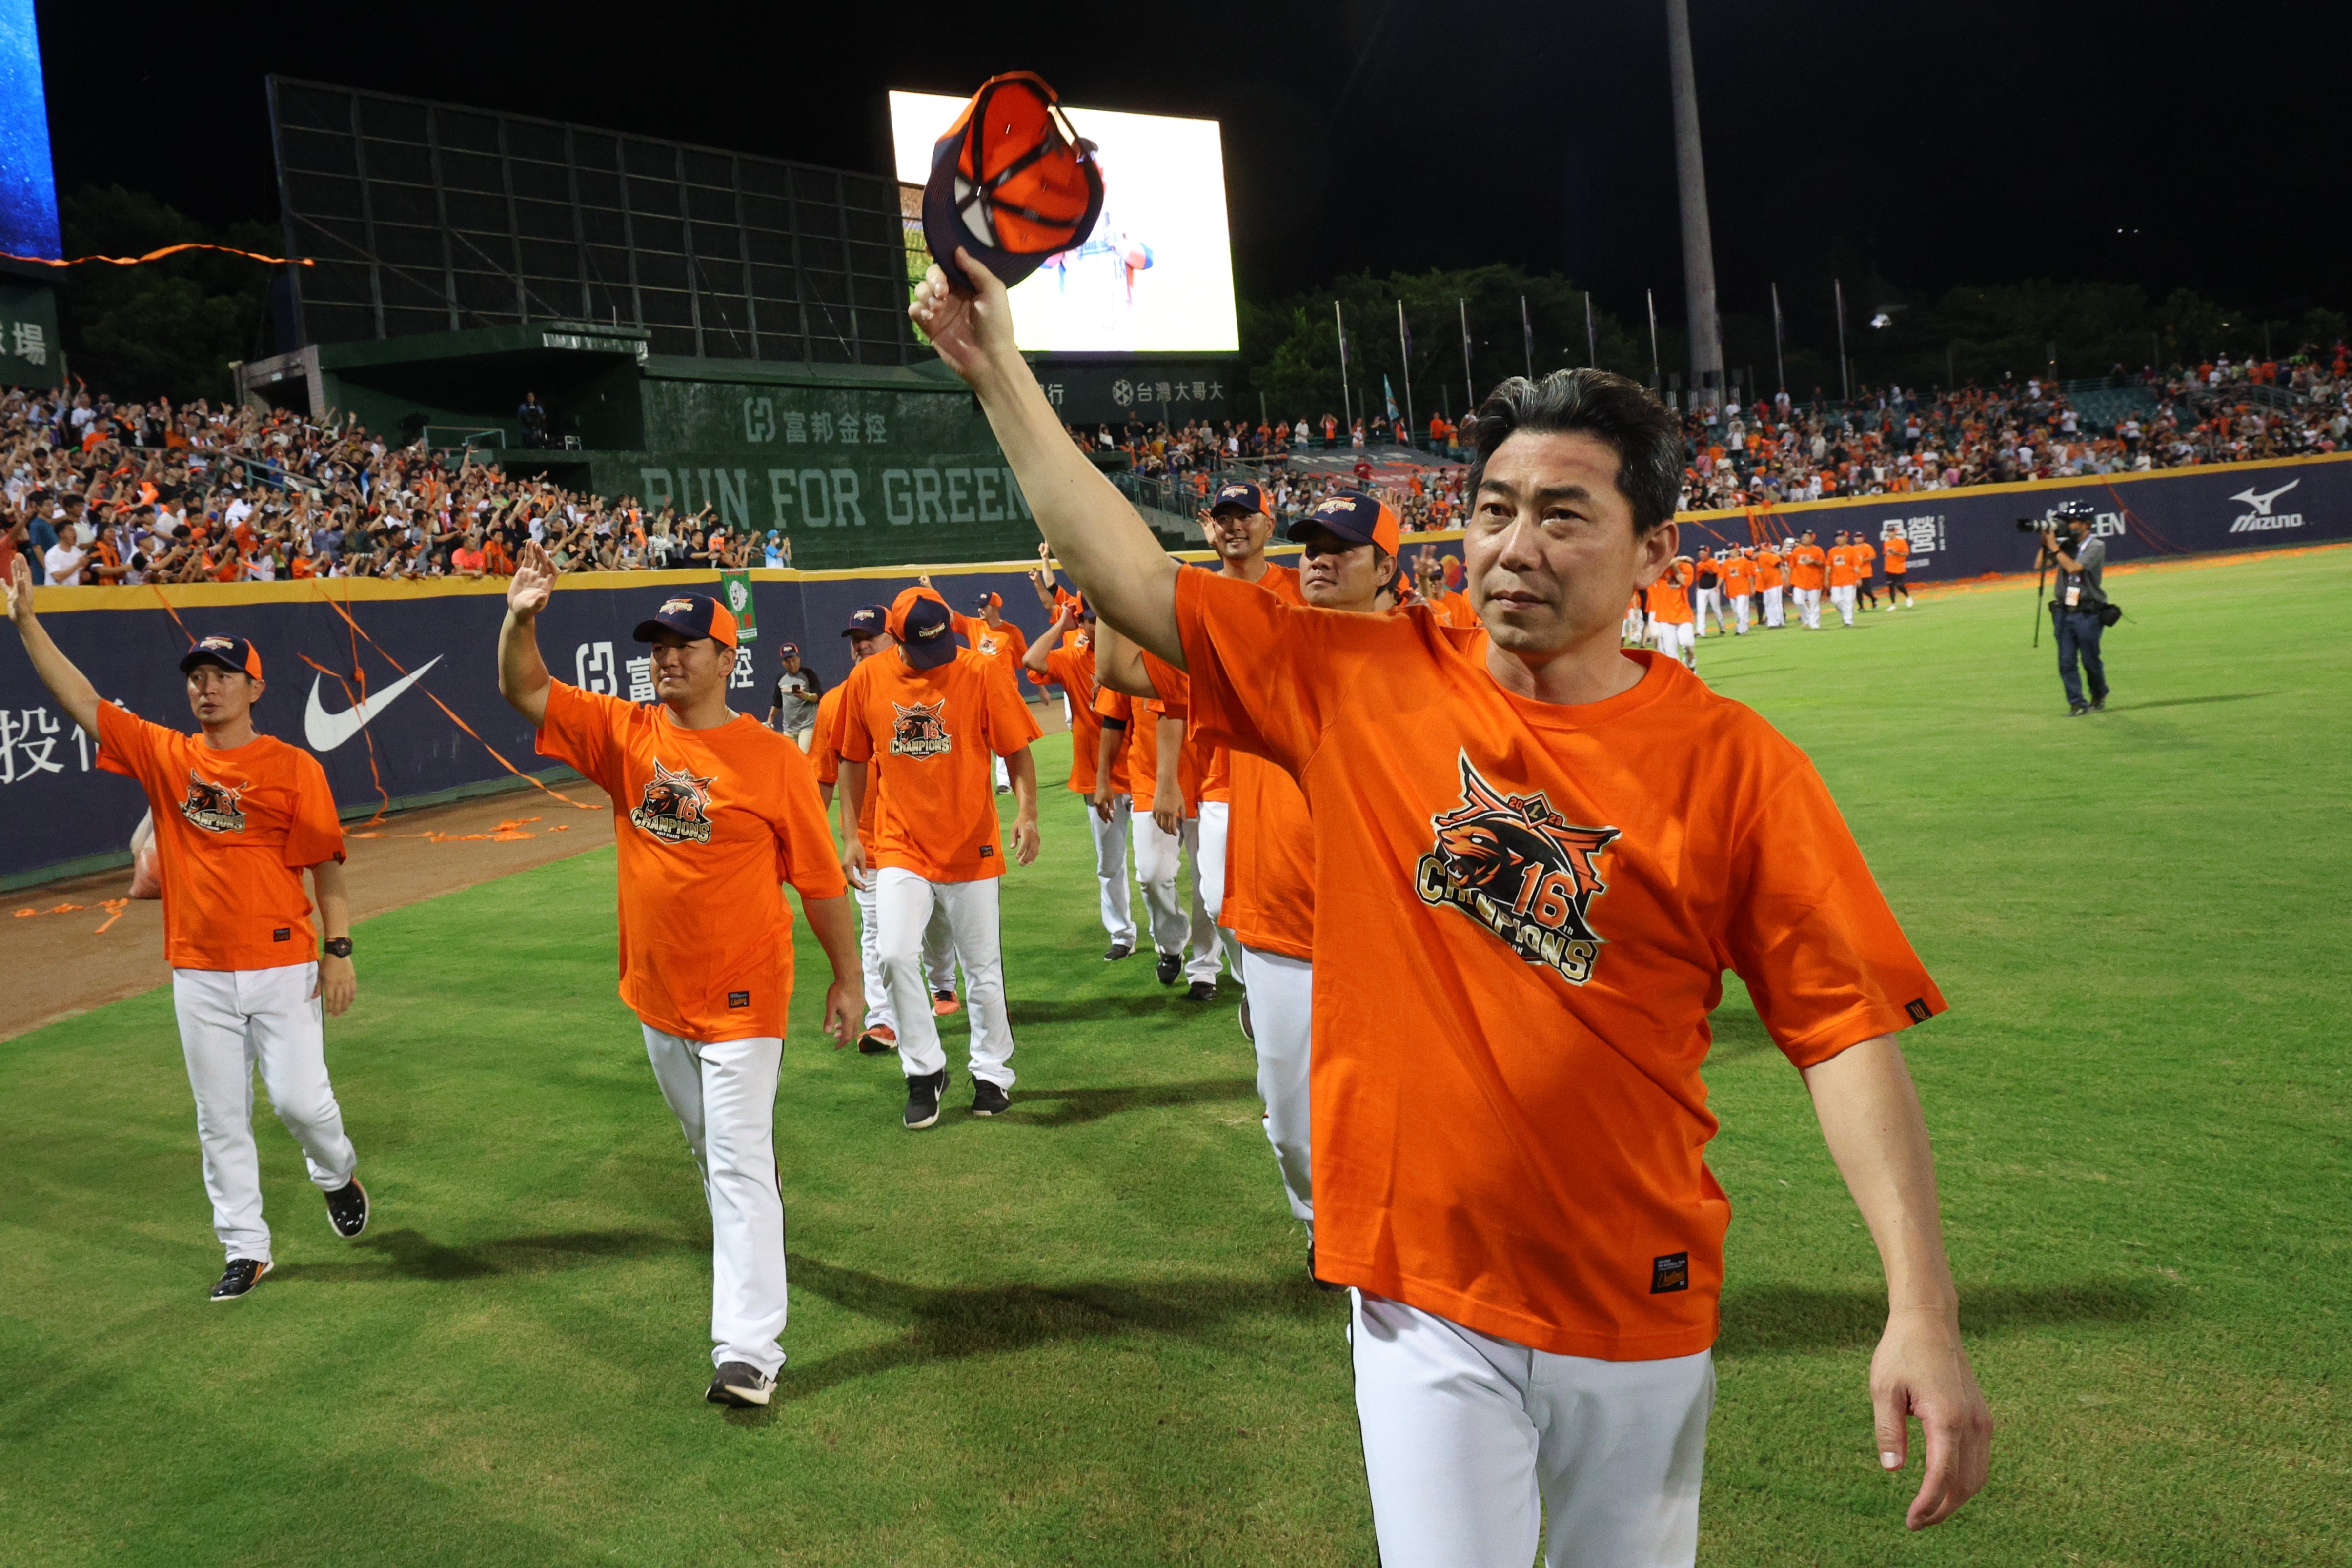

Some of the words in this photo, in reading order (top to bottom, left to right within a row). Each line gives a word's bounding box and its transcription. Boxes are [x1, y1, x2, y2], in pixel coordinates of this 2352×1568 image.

[0, 321, 46, 365] 場
[1040, 384, 1064, 404] 行
[1137, 382, 1224, 401] 台灣大哥大
[783, 411, 887, 443] 富邦金控
[641, 468, 750, 529] RUN
[768, 469, 866, 529] FOR
[891, 738, 950, 754] CHAMPIONS
[631, 809, 709, 841] CHAMPIONS
